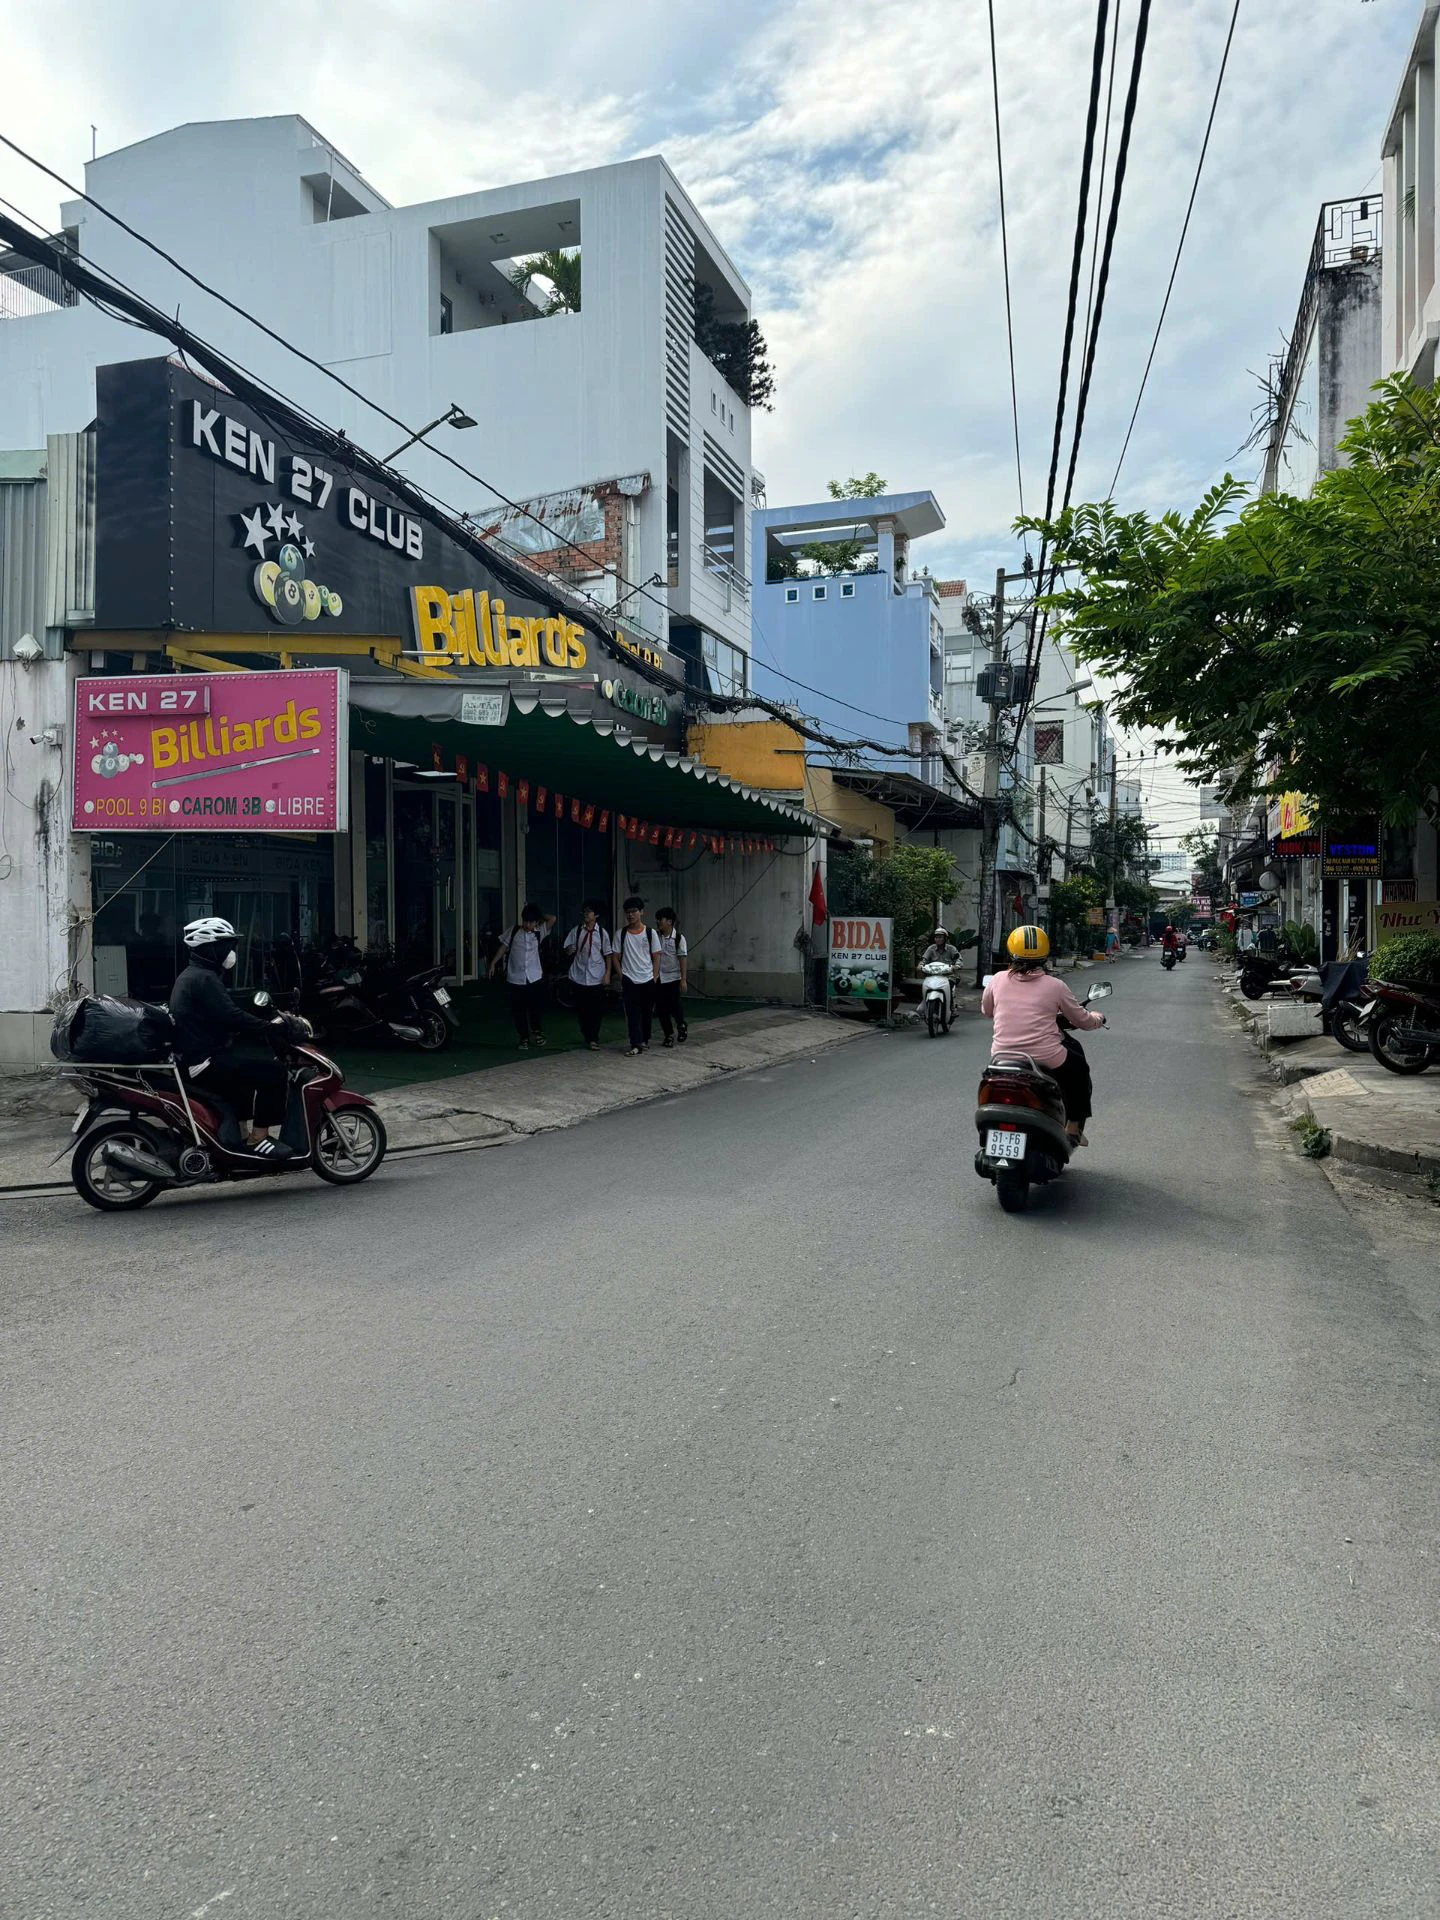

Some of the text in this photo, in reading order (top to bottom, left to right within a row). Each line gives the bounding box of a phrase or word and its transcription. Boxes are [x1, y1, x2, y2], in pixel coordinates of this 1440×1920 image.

[193, 399, 424, 560] KEN 27 CLUB
[412, 585, 586, 669] Billiards
[88, 690, 197, 712] KEN 27
[151, 699, 321, 769] Billiards
[96, 797, 166, 816] POOL 9 BI
[181, 796, 262, 816] CAROM 3B
[278, 797, 325, 816] LIBRE
[831, 920, 887, 950] BIDA
[831, 952, 849, 960] KEN
[865, 953, 887, 961] CLUB
[990, 1144, 1019, 1158] 9559
